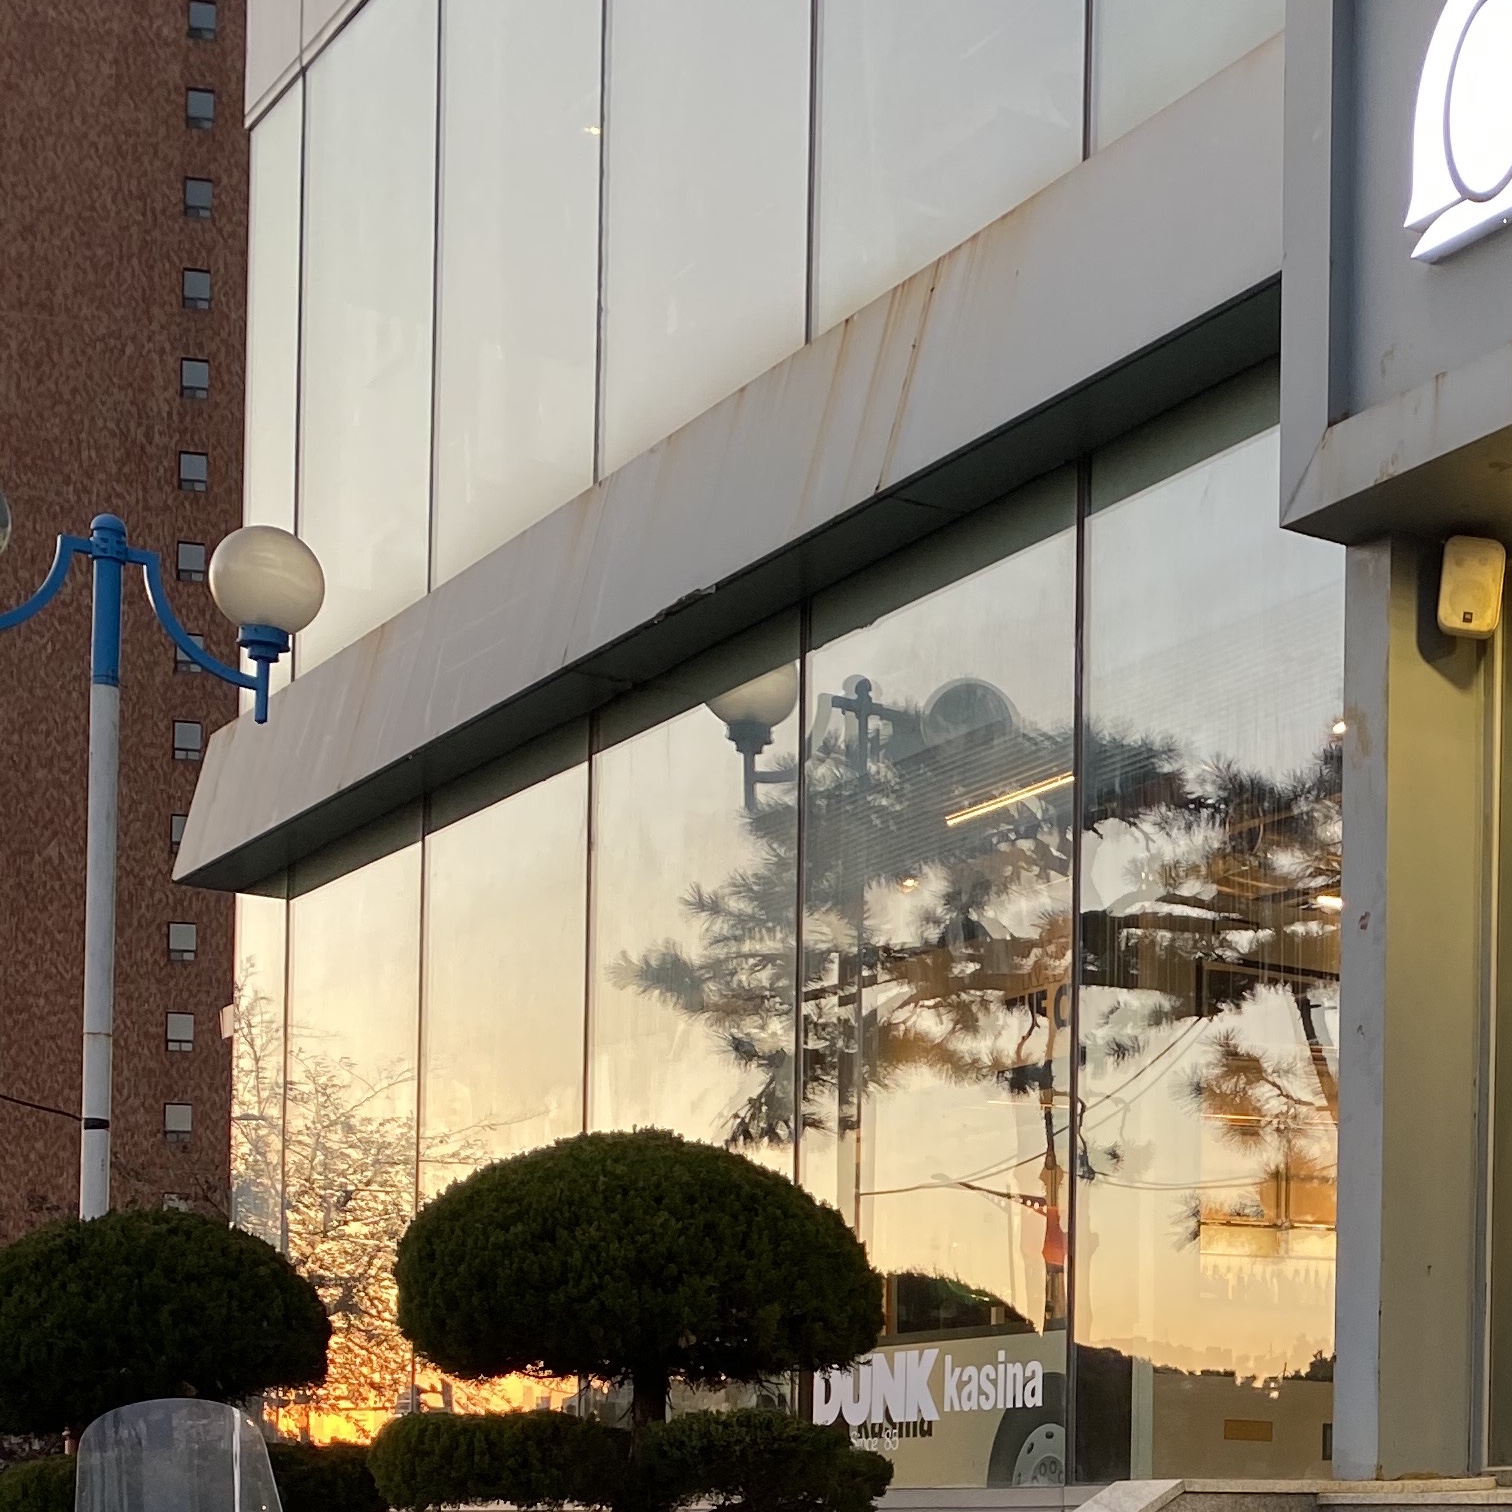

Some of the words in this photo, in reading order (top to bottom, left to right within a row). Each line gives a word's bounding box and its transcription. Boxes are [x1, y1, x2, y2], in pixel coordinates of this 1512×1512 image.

[813, 1348, 940, 1426] DUNK
[944, 1350, 1043, 1412] kasina
[850, 1430, 878, 1451] Since
